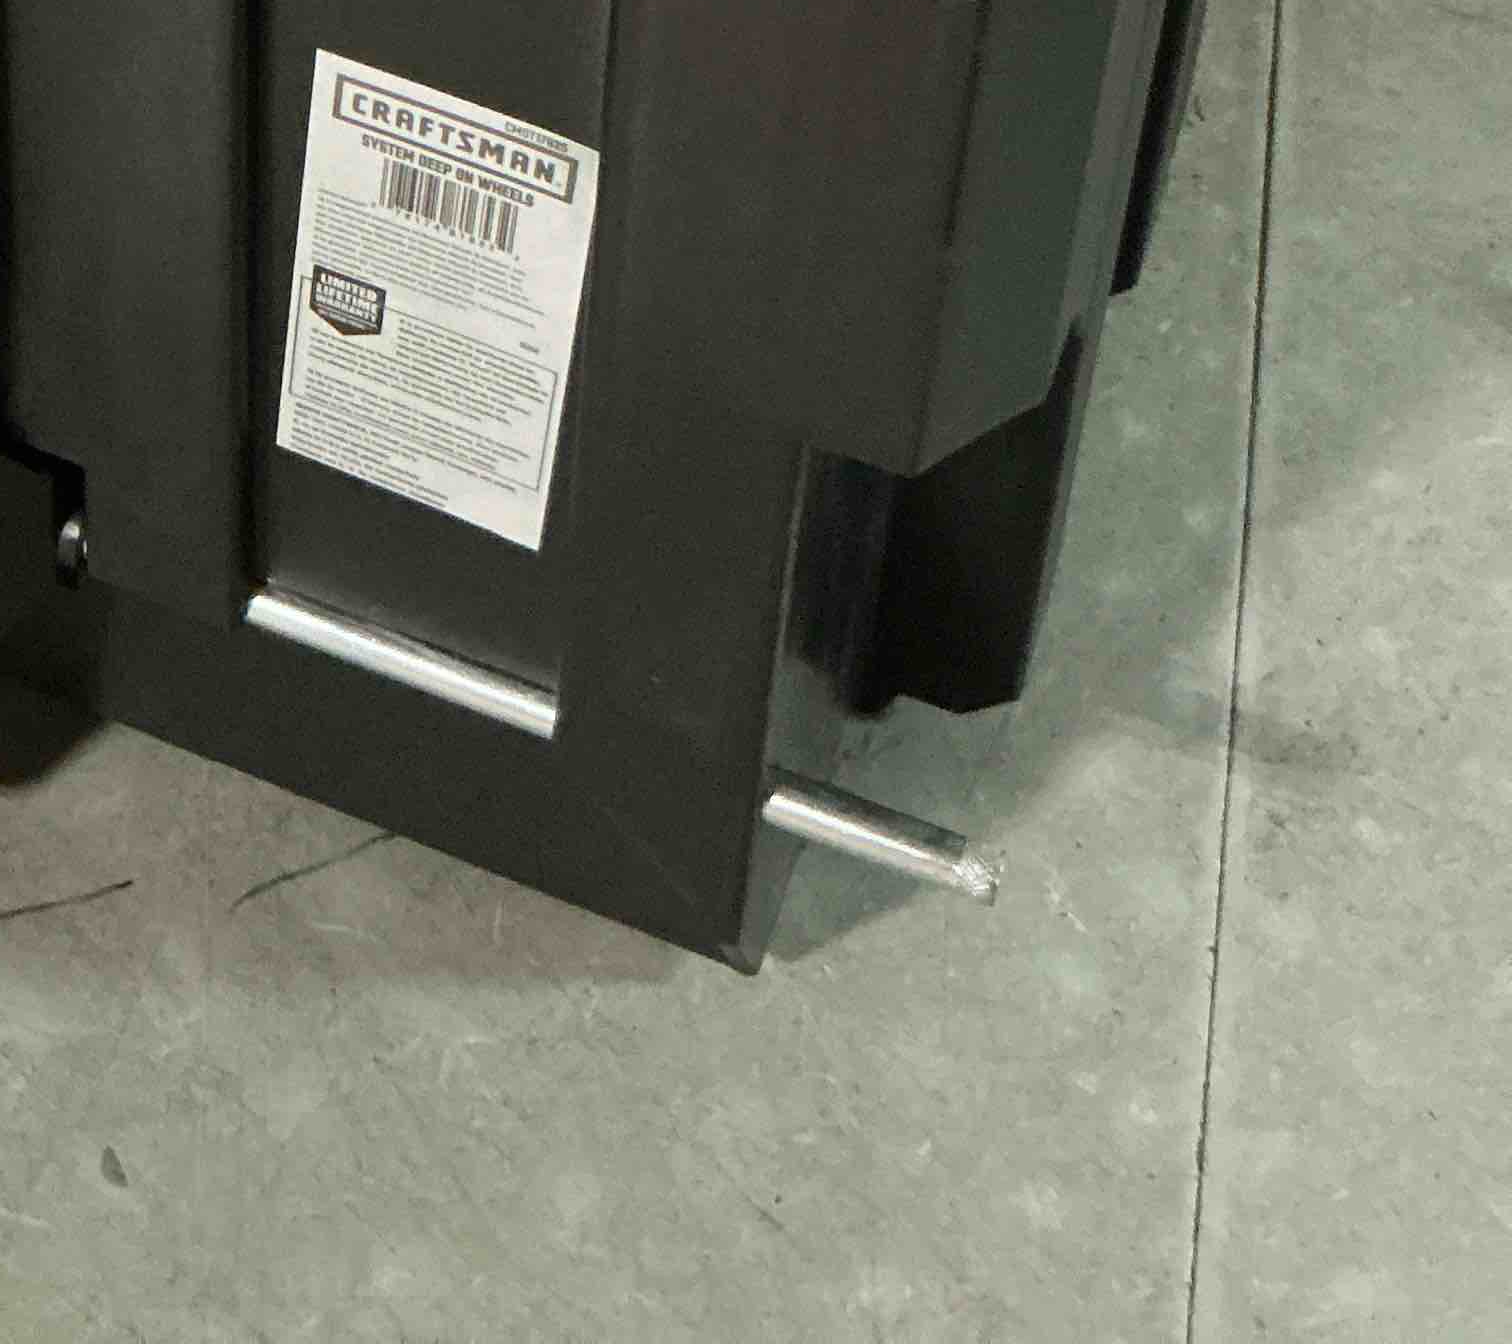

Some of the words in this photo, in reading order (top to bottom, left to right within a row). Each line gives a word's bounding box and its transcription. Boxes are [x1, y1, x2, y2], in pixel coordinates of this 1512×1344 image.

[351, 92, 556, 185] CRAFTSMAN
[361, 133, 417, 162] SYSTEM
[418, 154, 453, 176] DEEP
[455, 167, 475, 185] ON
[476, 174, 536, 208] WHEELS
